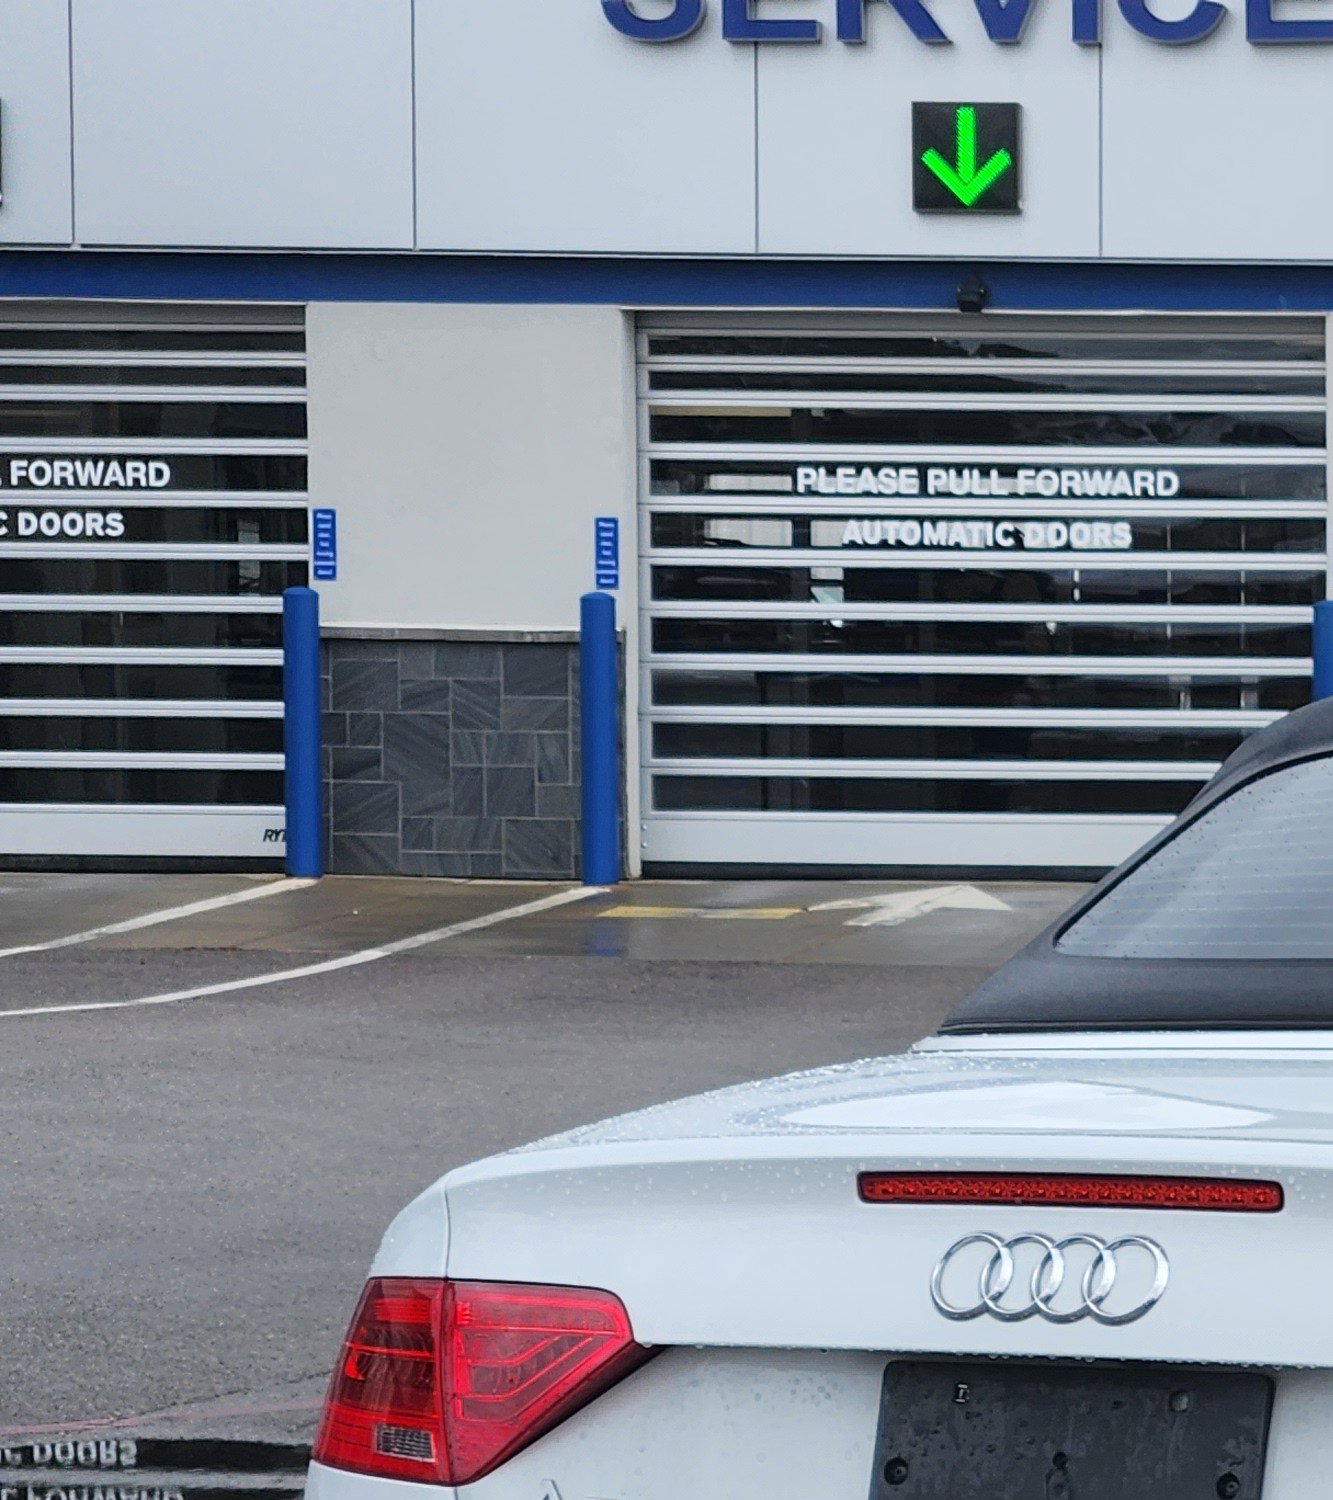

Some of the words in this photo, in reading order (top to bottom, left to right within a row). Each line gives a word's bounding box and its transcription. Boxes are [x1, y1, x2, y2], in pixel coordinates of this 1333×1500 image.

[10, 459, 171, 487] FORWARD
[796, 467, 919, 494] PLEASE
[927, 468, 1009, 496] PULL
[1016, 469, 1180, 497] FORWARD
[17, 511, 125, 537] DOORS
[842, 519, 1016, 548] AUTOMATIC
[1023, 521, 1133, 550] DOORS
